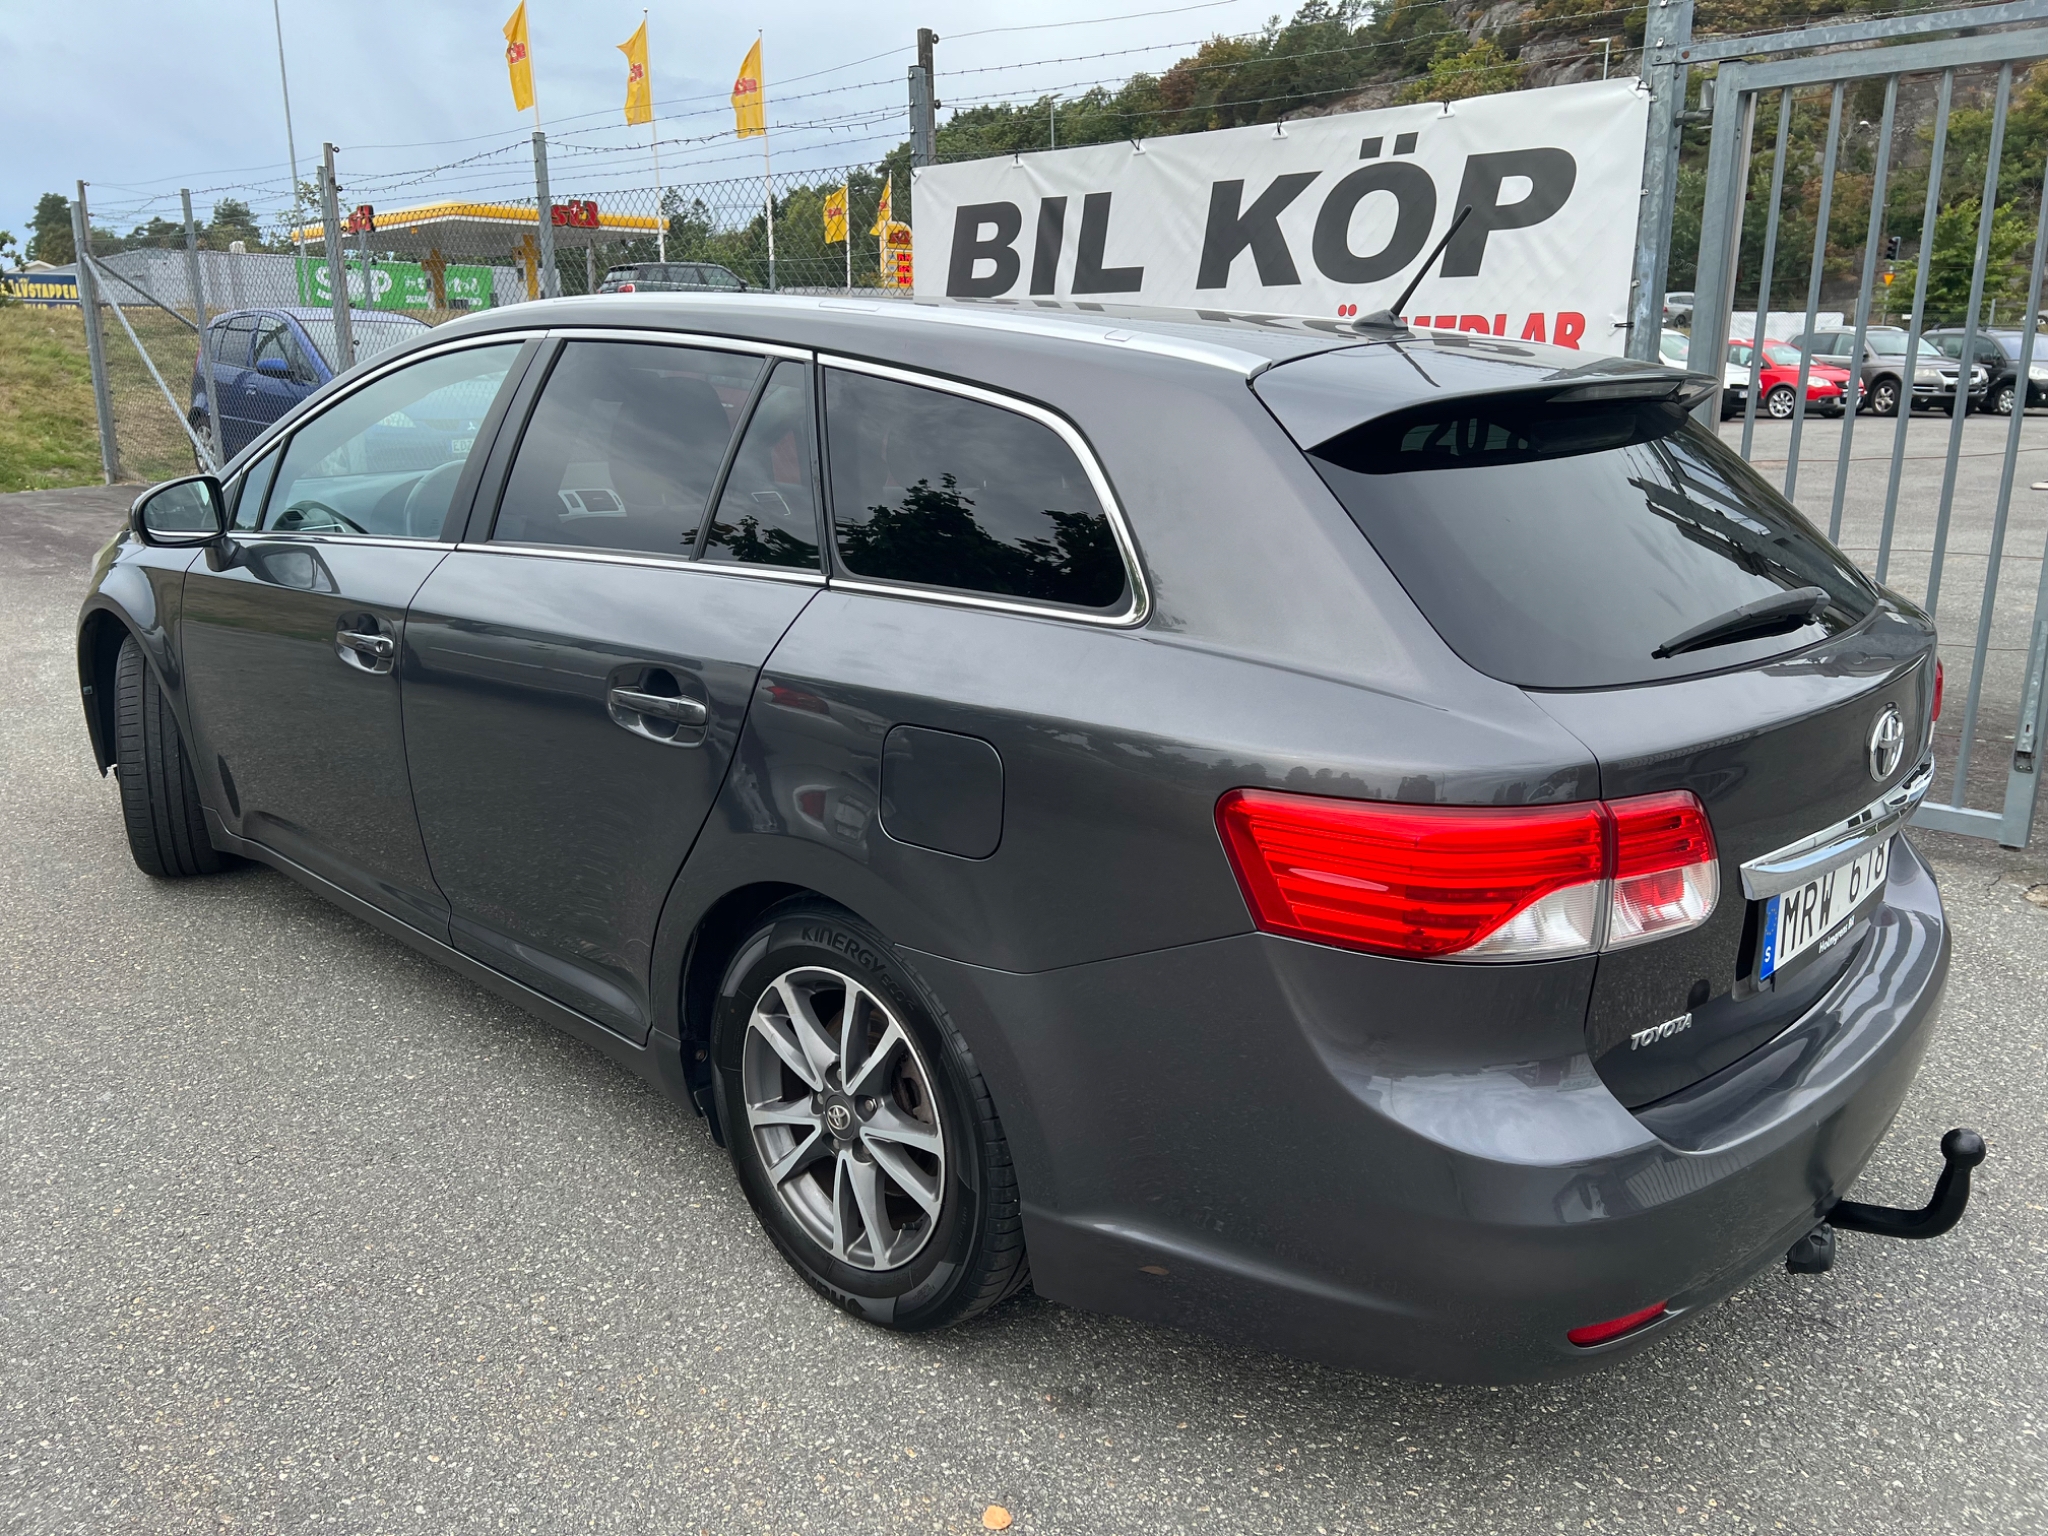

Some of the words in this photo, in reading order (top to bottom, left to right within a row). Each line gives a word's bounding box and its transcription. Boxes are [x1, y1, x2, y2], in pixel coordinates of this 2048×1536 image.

[946, 191, 1145, 299] BIL
[1195, 132, 1578, 291] KÖP
[1780, 870, 1836, 960] MRW
[1764, 945, 1772, 963] S
[1630, 1012, 1692, 1051] TOYOTA
